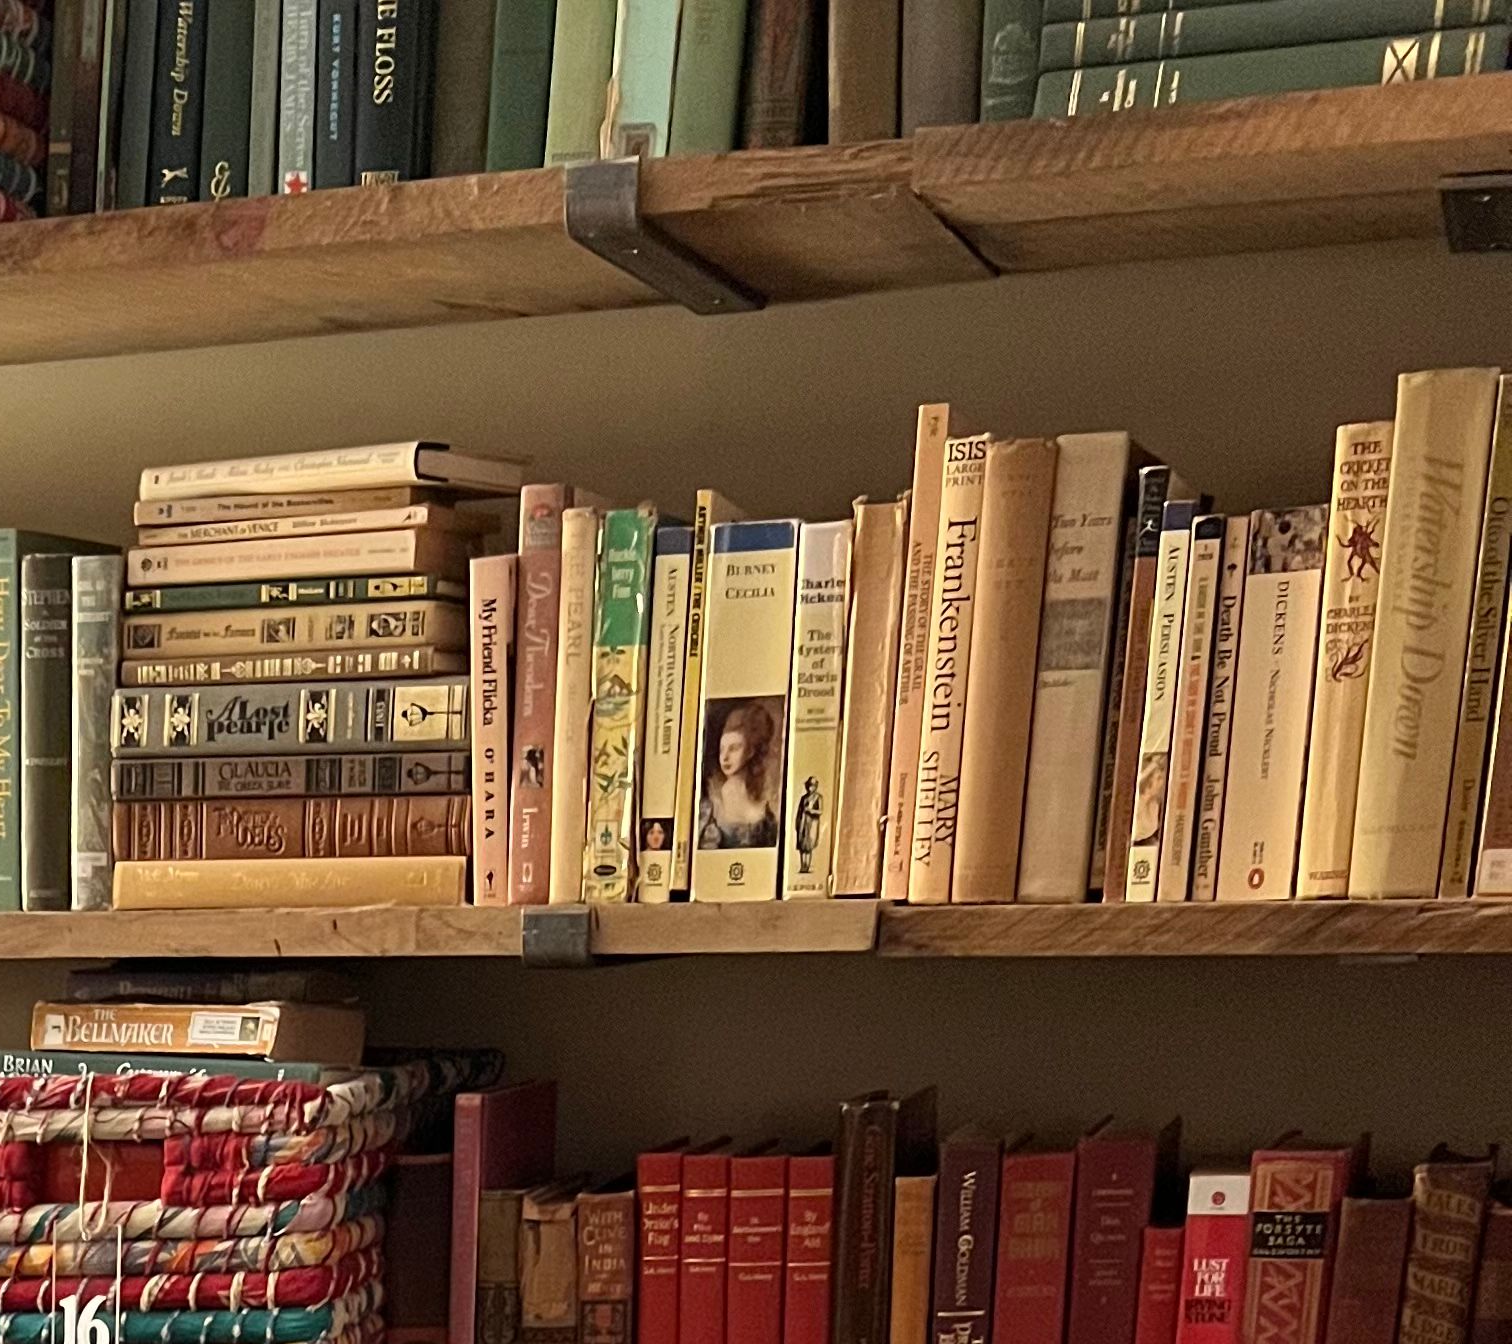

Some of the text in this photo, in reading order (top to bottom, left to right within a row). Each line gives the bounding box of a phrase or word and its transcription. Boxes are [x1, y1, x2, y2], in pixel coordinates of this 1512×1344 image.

[171, 1, 194, 136] Watership Down
[329, 13, 342, 141] KURT VONNEGUT
[372, 28, 395, 105] FLOSS
[947, 442, 986, 460] ISIS
[1351, 442, 1382, 453] THE
[688, 505, 708, 658] ARTHUR MILLER THE CRUCIBLE
[724, 588, 775, 599] CECILIA
[726, 565, 777, 576] BURNEY
[567, 588, 583, 663] PEARL
[930, 518, 977, 732] Frankenstein
[1154, 544, 1180, 701] AUSTEN PERSUASION
[1272, 581, 1290, 655] DICKENS
[1392, 453, 1464, 760] Watership Down
[1465, 496, 1507, 724] Otto of the Silver Hand
[661, 568, 680, 756] AUSTEN NORTHANGER ABBEY
[237, 703, 290, 721] Lost
[480, 598, 498, 840] My Friend Flicka O'HARA
[1196, 594, 1238, 879] Death Be Not Proud John Gunther
[218, 761, 292, 782] GLAUCIA
[521, 807, 539, 848] Irwin
[914, 750, 938, 867] SHELLEY
[935, 774, 959, 846] MARY
[65, 1015, 173, 1046] BELLMAKER
[93, 1008, 116, 1022] THE
[3, 1055, 53, 1073] BRIAN
[955, 1171, 976, 1307] WILLIAM GOLDMAN
[1256, 1223, 1324, 1235] FORSYTE
[1268, 1236, 1305, 1246] SAGA
[1277, 1215, 1299, 1224] THE
[1194, 1258, 1229, 1270] LUST
[1194, 1284, 1227, 1298] LIFE
[1197, 1272, 1225, 1284] FOR
